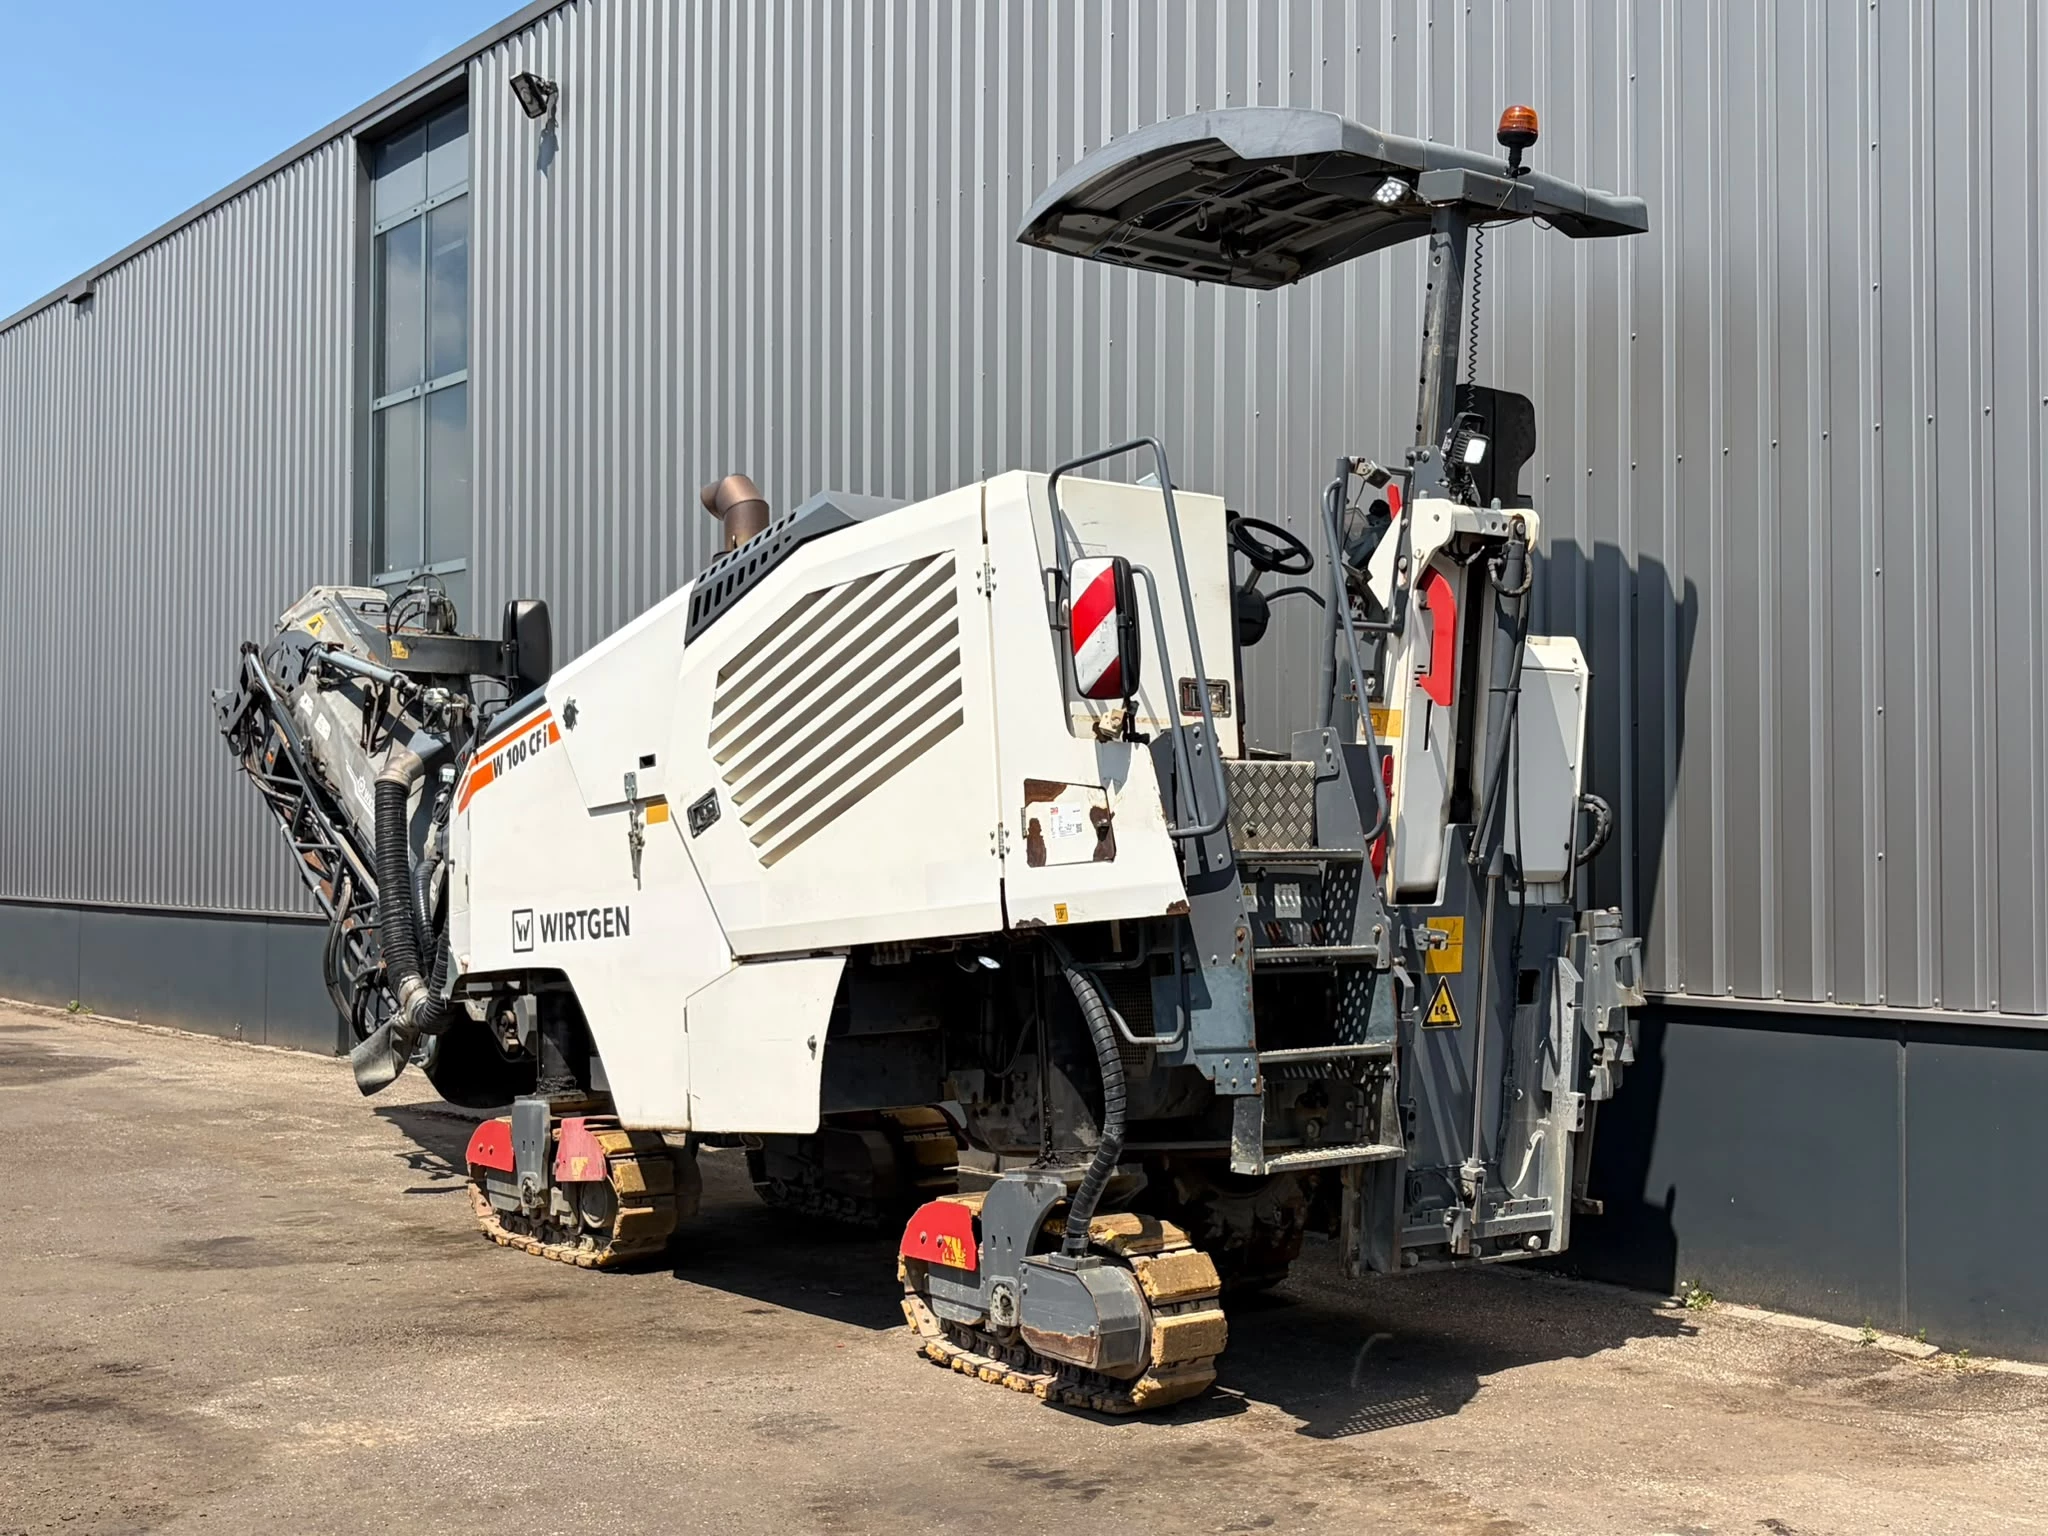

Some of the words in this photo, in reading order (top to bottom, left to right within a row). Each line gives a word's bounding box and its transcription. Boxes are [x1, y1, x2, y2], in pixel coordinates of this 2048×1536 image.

[493, 753, 504, 778] W
[506, 740, 527, 770] 100
[540, 905, 630, 943] WIRTGEN
